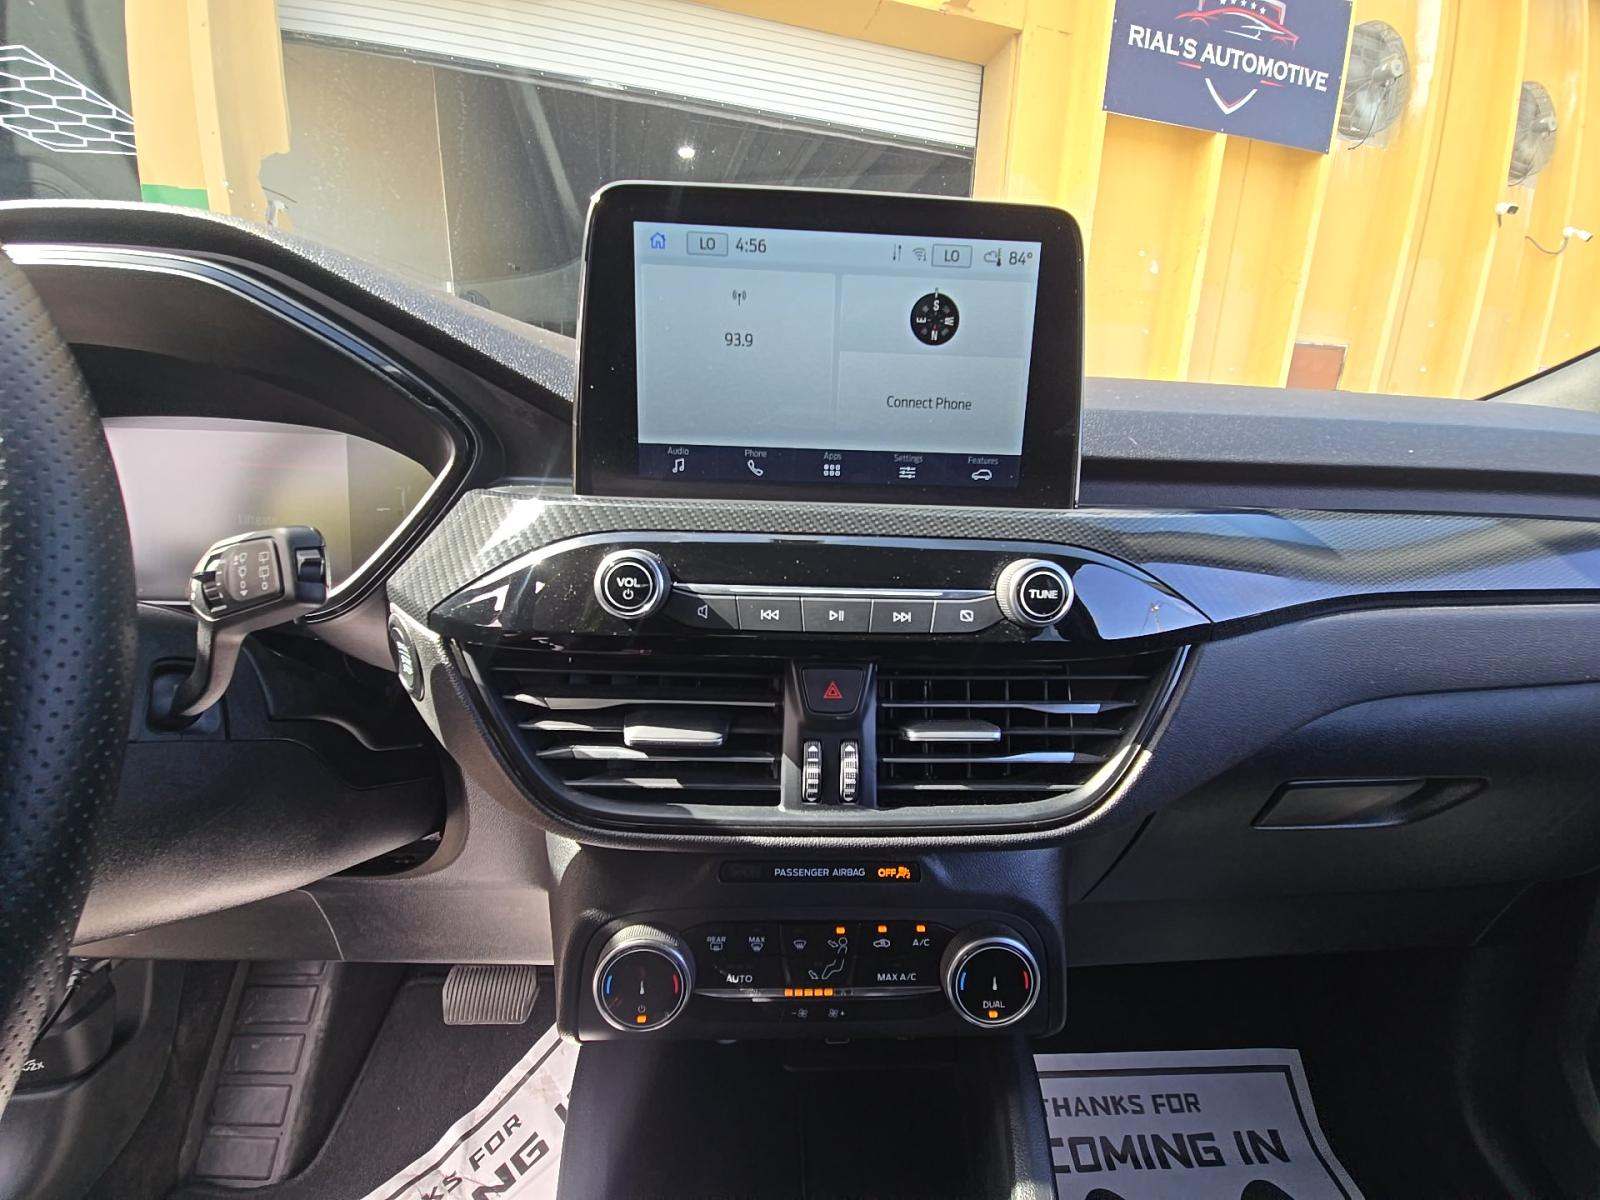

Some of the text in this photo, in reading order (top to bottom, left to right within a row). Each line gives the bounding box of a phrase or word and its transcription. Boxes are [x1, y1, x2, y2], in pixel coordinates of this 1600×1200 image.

[1128, 24, 1329, 92] RIAL'S AUTOMOTIVE
[699, 237, 716, 251] LO
[735, 238, 767, 253] 4:56
[944, 250, 960, 262] LO
[1008, 251, 1033, 265] 84°
[933, 299, 940, 311] S
[724, 332, 754, 347] 93.9
[886, 395, 972, 411] Connect Phone
[667, 446, 690, 456] Audio
[744, 449, 767, 458] Phone
[823, 451, 842, 461] Apps
[893, 453, 923, 464] Settings
[967, 456, 999, 465] Features
[616, 576, 641, 588] VOL
[1028, 588, 1059, 599] TUNE
[774, 868, 897, 878] PASSENGER AIRBAG OFF
[912, 938, 930, 947] A/C
[726, 973, 753, 983] AUTO
[876, 972, 917, 982] MAX A/C
[982, 1000, 1006, 1009] DUAL
[1151, 1092, 1202, 1115] FOR
[468, 1114, 522, 1172] FOR
[1232, 1128, 1291, 1166] IN
